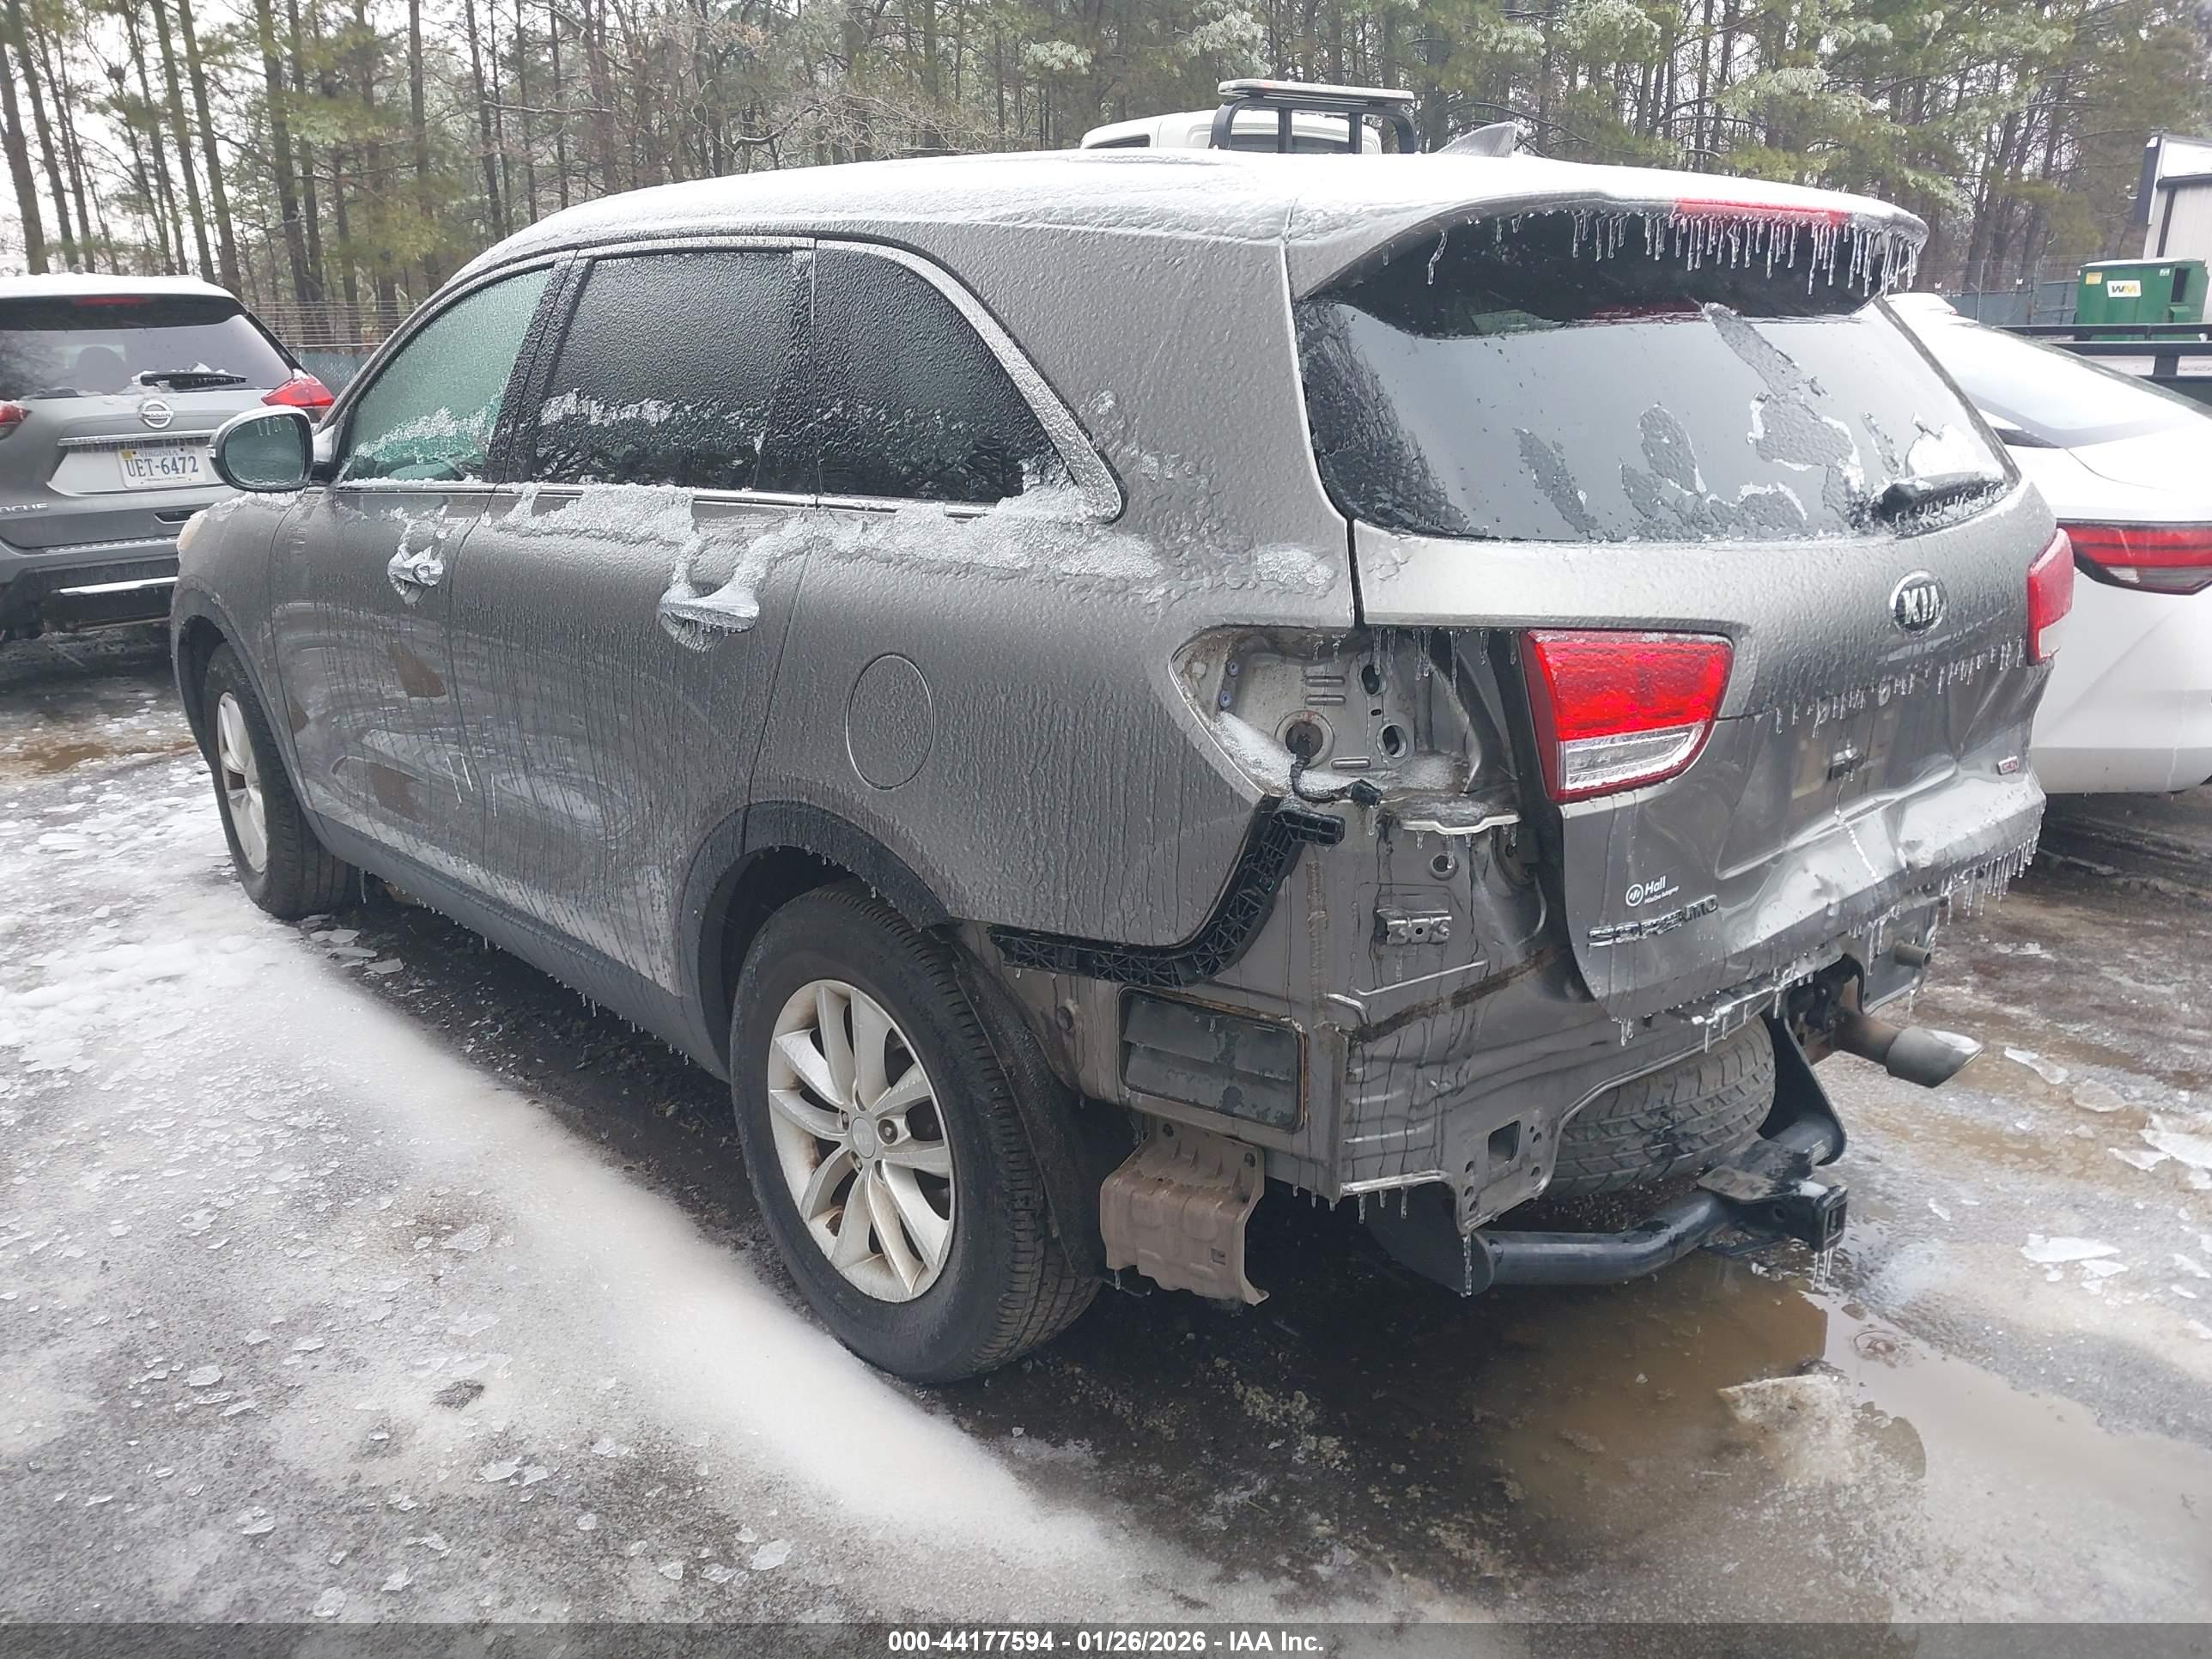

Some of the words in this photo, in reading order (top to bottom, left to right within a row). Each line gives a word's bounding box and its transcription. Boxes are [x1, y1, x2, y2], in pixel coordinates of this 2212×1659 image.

[2112, 284, 2137, 295] WM
[137, 449, 179, 458] VIRGINIA
[125, 455, 199, 477] UET-6472
[1900, 585, 1940, 625] KIA
[1644, 875, 1667, 896] Hall
